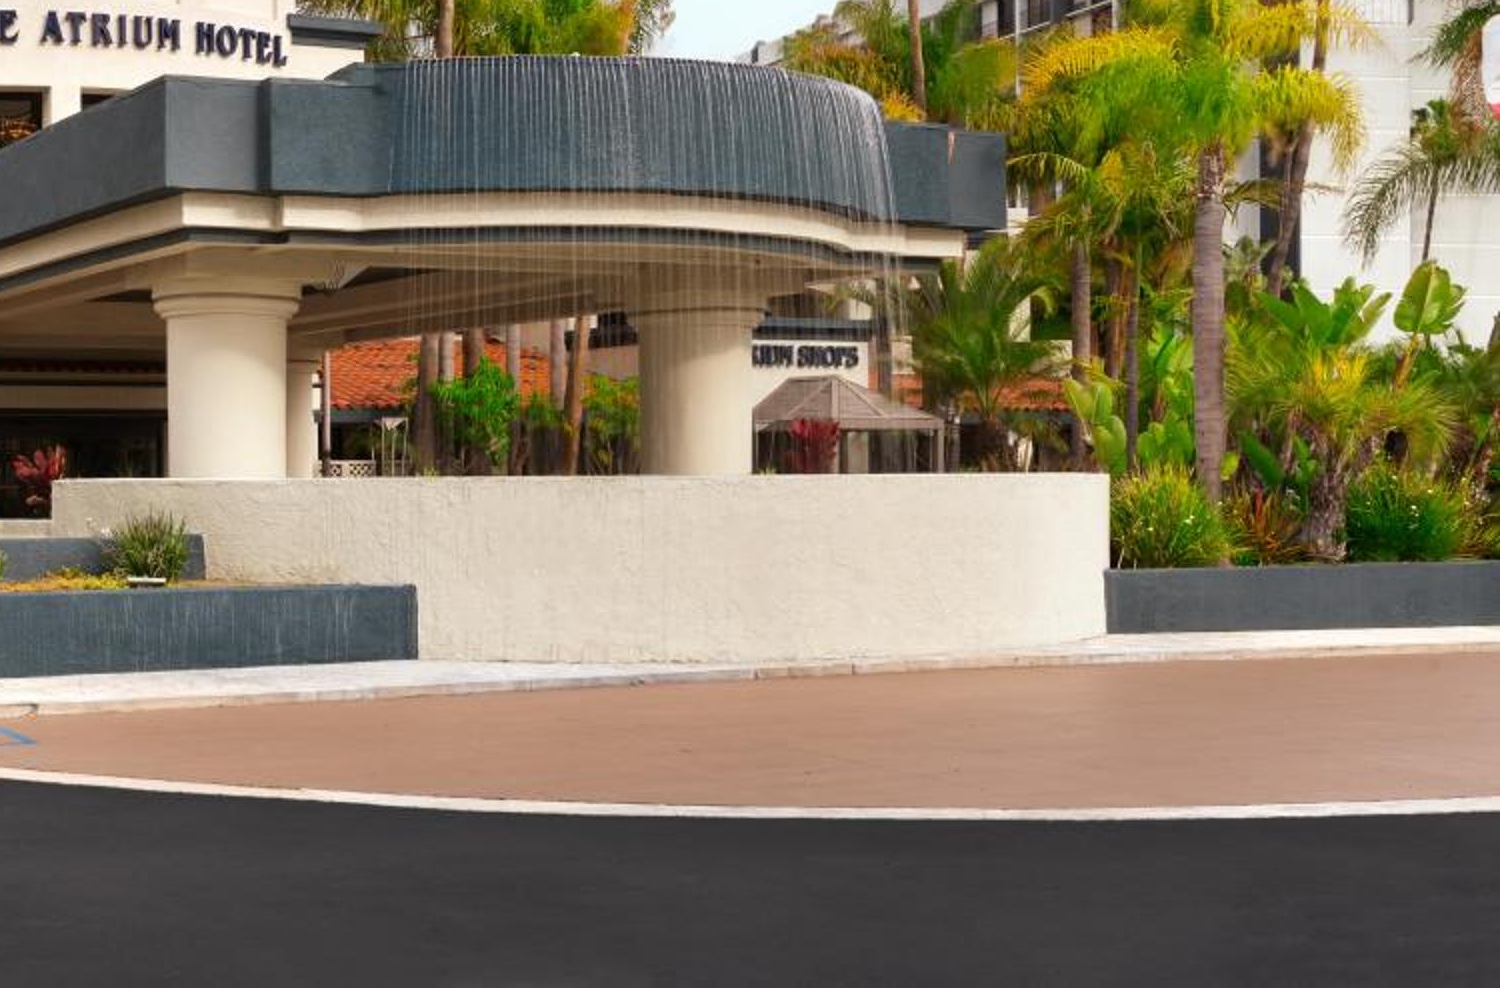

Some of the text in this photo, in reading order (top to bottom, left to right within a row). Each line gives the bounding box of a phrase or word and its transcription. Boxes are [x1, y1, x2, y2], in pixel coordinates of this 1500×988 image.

[40, 10, 182, 51] ATRIUM
[195, 21, 287, 68] HOTEL
[797, 345, 858, 369] SHOPS
